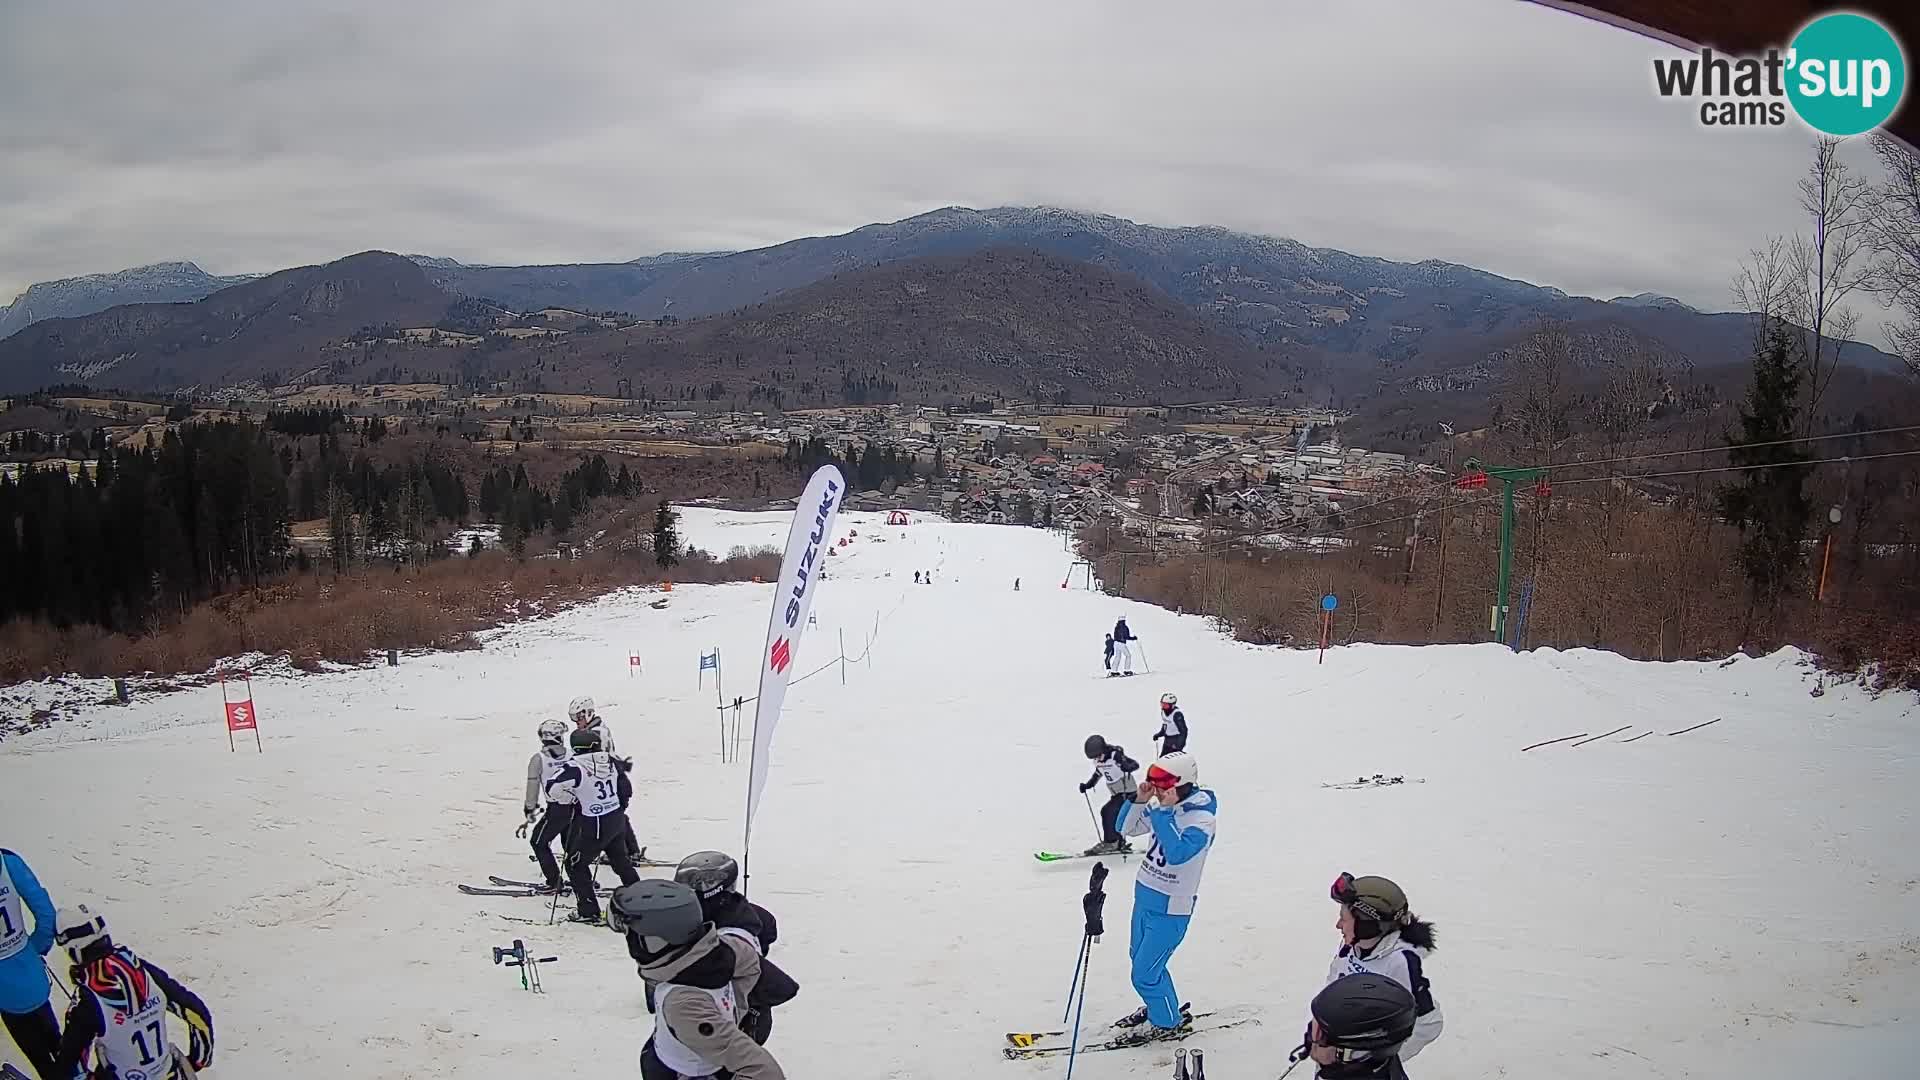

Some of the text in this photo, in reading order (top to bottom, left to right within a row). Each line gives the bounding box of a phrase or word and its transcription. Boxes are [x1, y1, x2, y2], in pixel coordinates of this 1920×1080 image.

[786, 479, 839, 628] SUZUKI
[594, 779, 616, 800] 31
[131, 1020, 163, 1066] 17
